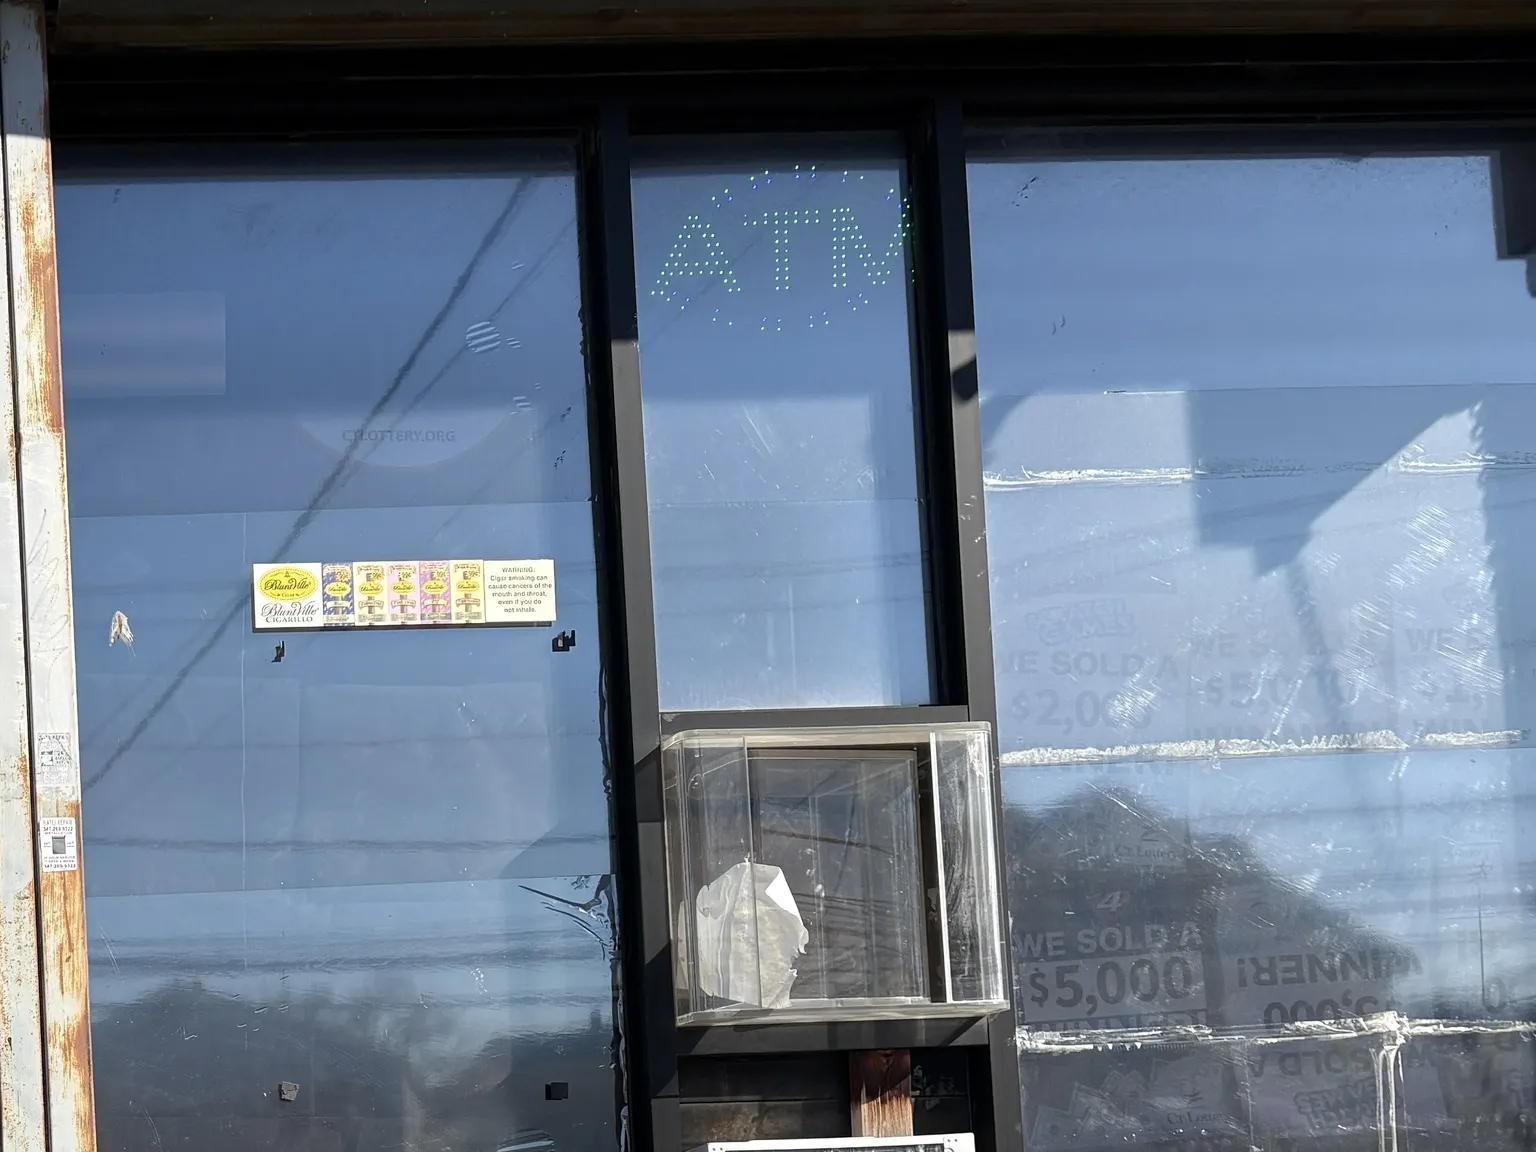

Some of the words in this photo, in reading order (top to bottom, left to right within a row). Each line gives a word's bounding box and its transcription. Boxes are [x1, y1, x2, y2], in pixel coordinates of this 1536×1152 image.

[651, 206, 914, 292] ATM
[1015, 931, 1066, 958] WE
[1077, 925, 1167, 954] SOLD
[1179, 922, 1202, 947] A
[1028, 956, 1194, 1016] $5,000
